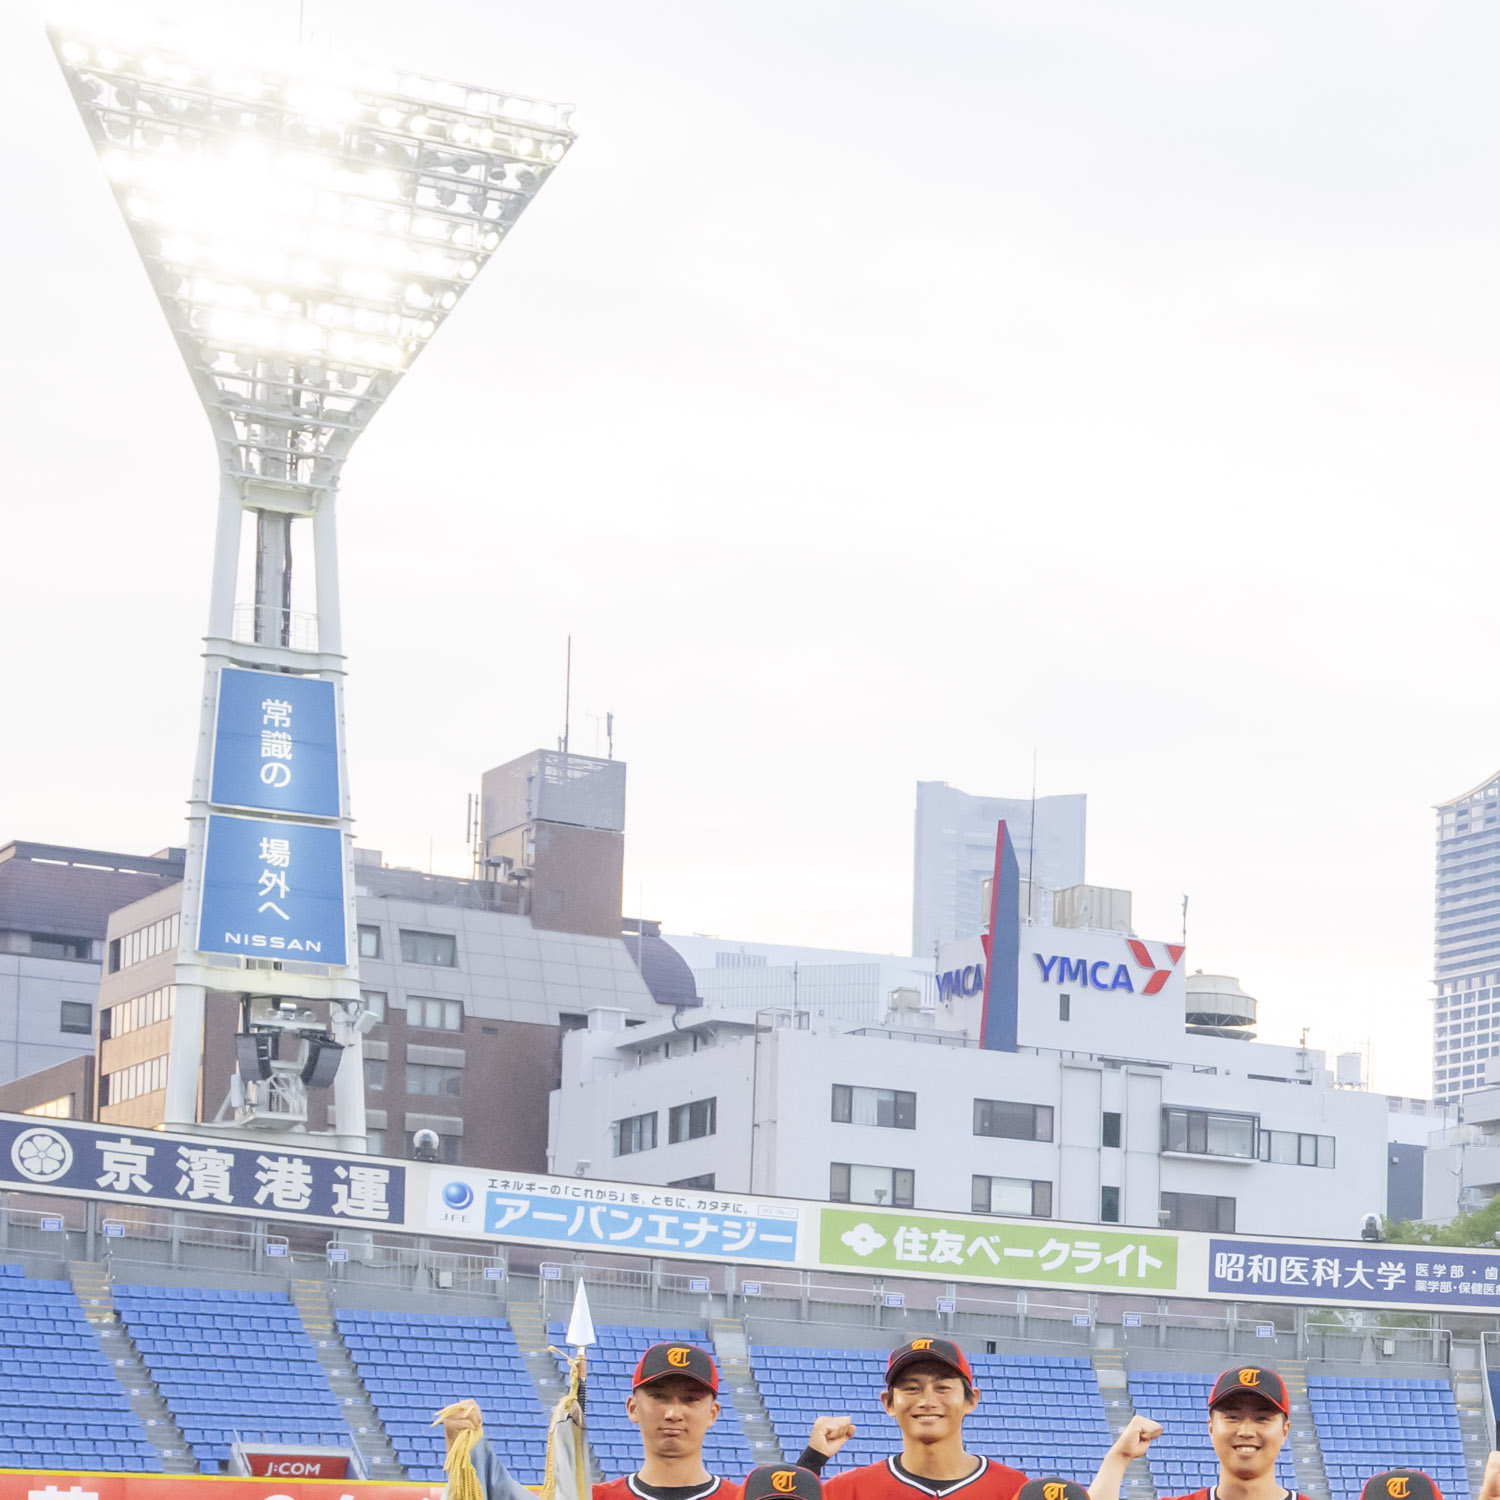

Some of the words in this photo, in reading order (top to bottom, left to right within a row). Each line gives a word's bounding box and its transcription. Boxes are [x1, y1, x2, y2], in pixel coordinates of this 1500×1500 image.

[260, 698, 293, 788] 常識の
[258, 837, 291, 921] 場外へ
[224, 931, 322, 953] NISSAN
[1033, 952, 1135, 994] YMCA
[494, 1196, 793, 1252] アーバンエナジー
[892, 1226, 1164, 1279] 住友ベークライト
[1214, 1252, 1407, 1292] 昭和医科大学
[264, 1461, 321, 1477] J:COM
